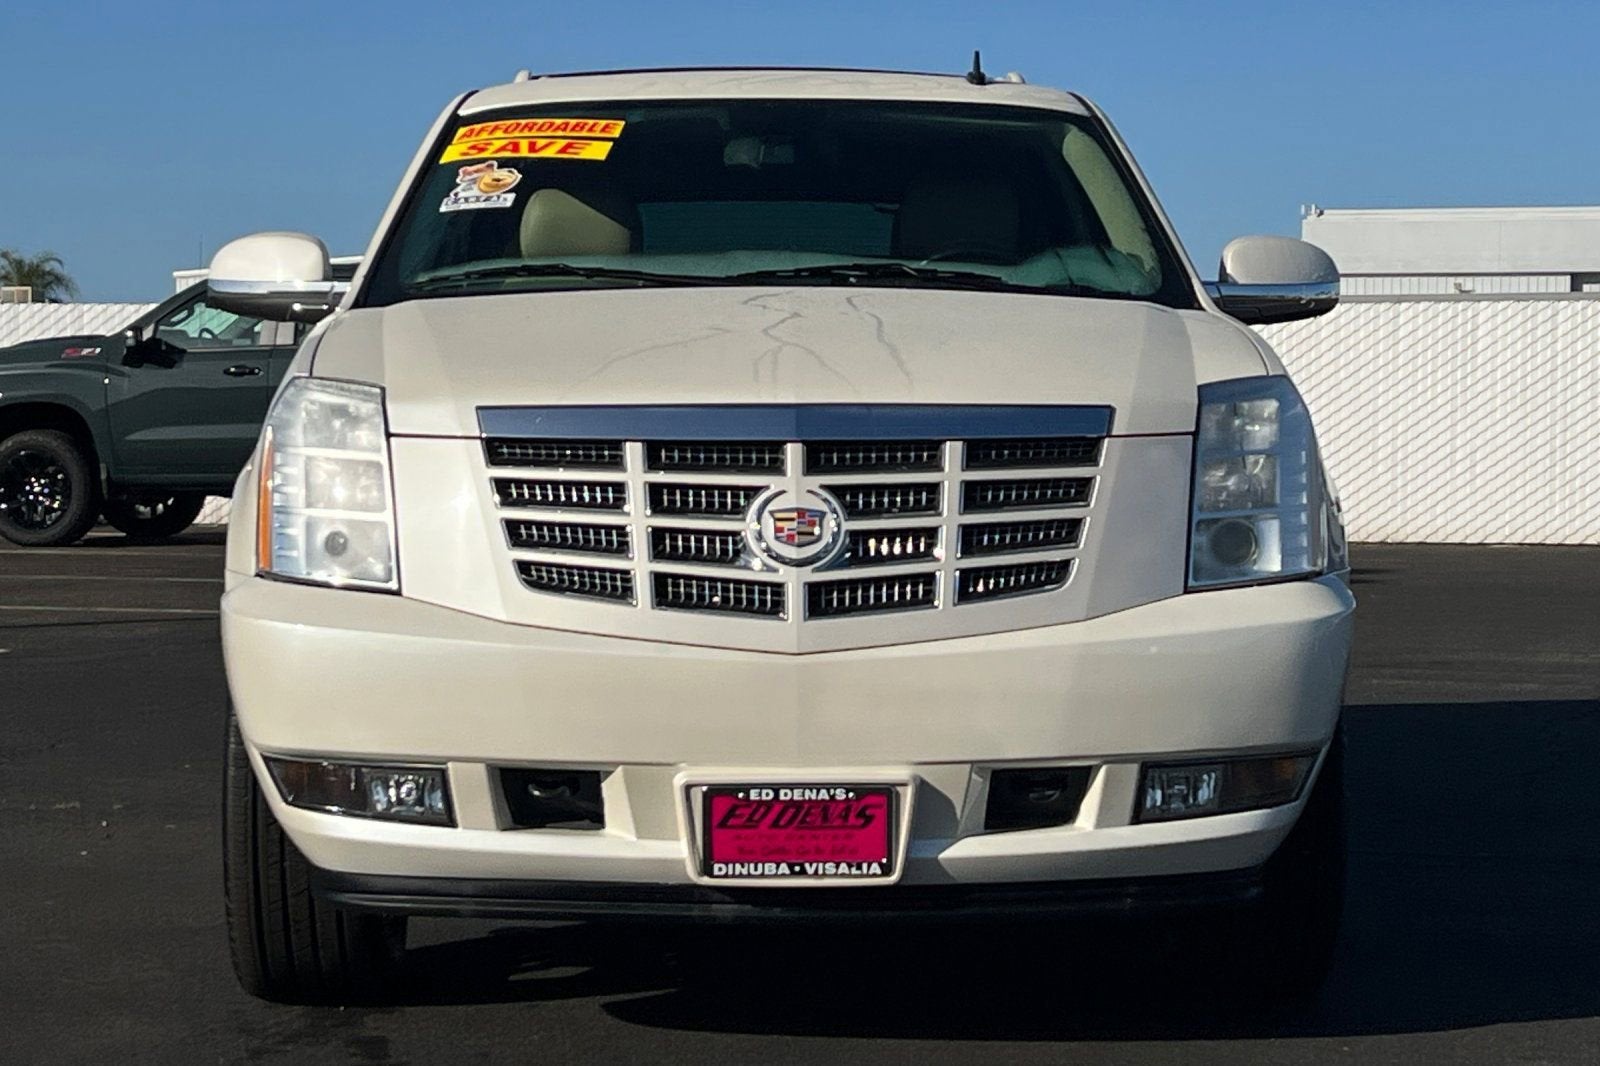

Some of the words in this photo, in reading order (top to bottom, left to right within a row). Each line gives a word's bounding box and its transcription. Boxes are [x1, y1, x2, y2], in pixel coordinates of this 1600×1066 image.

[459, 119, 619, 139] AFFORDABLE
[460, 140, 593, 157] SAVE
[749, 788, 775, 801] ED
[779, 788, 847, 801] DENA'S
[716, 803, 775, 829] ED
[713, 862, 791, 876] DINUBA
[804, 862, 882, 876] VISALIA
